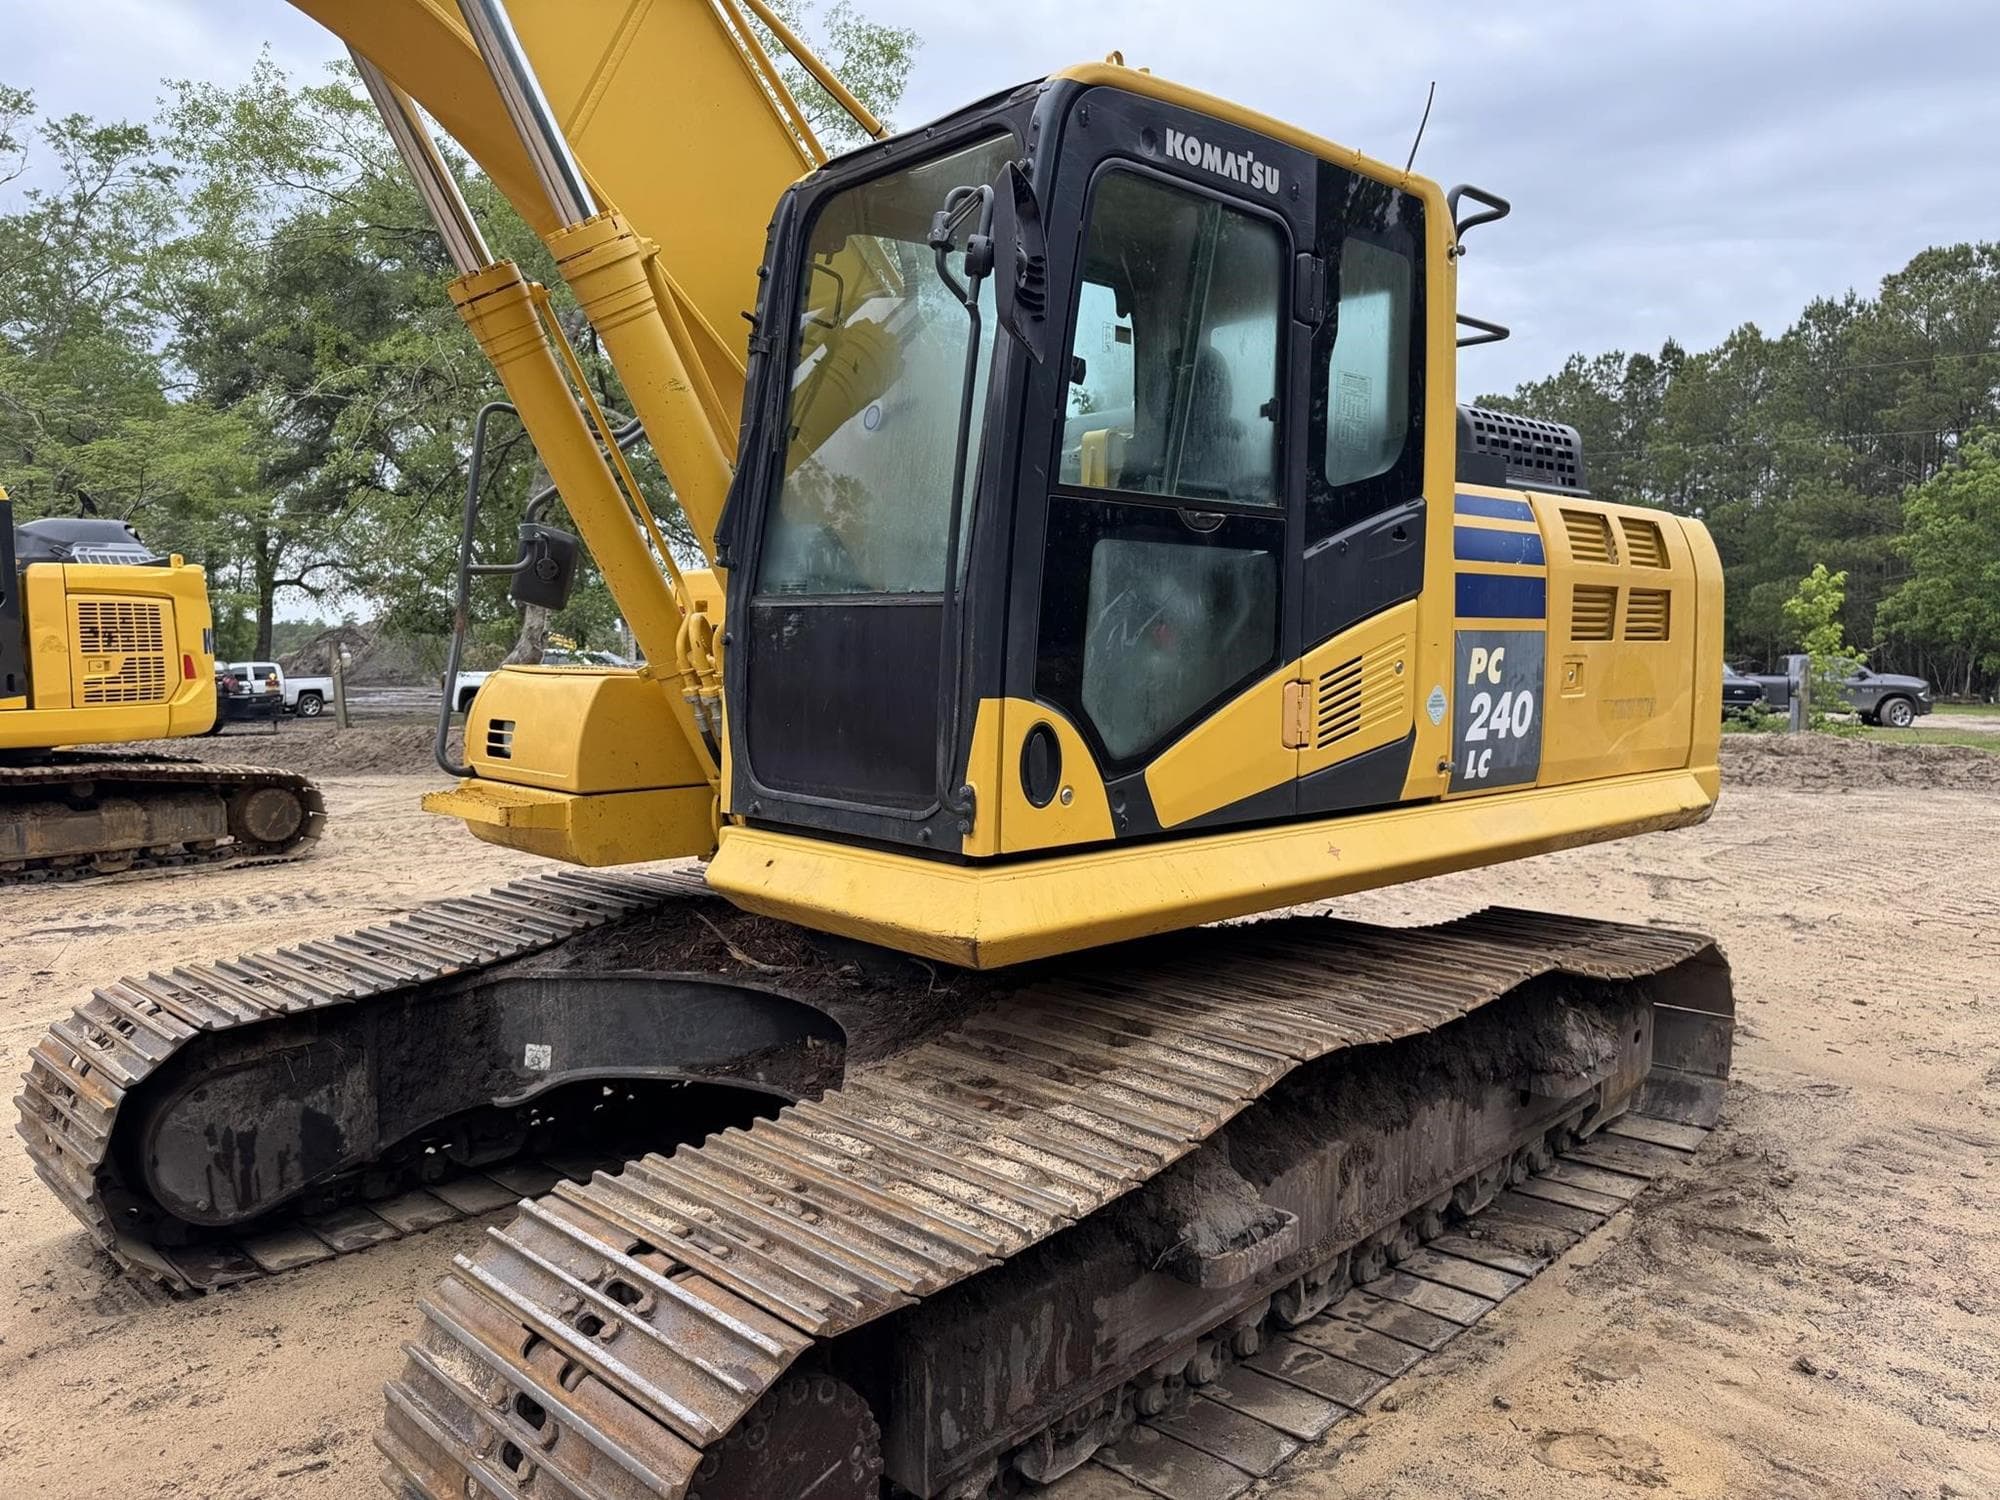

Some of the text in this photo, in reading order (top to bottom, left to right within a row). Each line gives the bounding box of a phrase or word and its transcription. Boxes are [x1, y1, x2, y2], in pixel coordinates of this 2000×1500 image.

[1166, 128, 1280, 195] KOMATSU
[1467, 647, 1505, 685] PC
[1465, 690, 1534, 742] 240
[1464, 748, 1492, 780] LC
